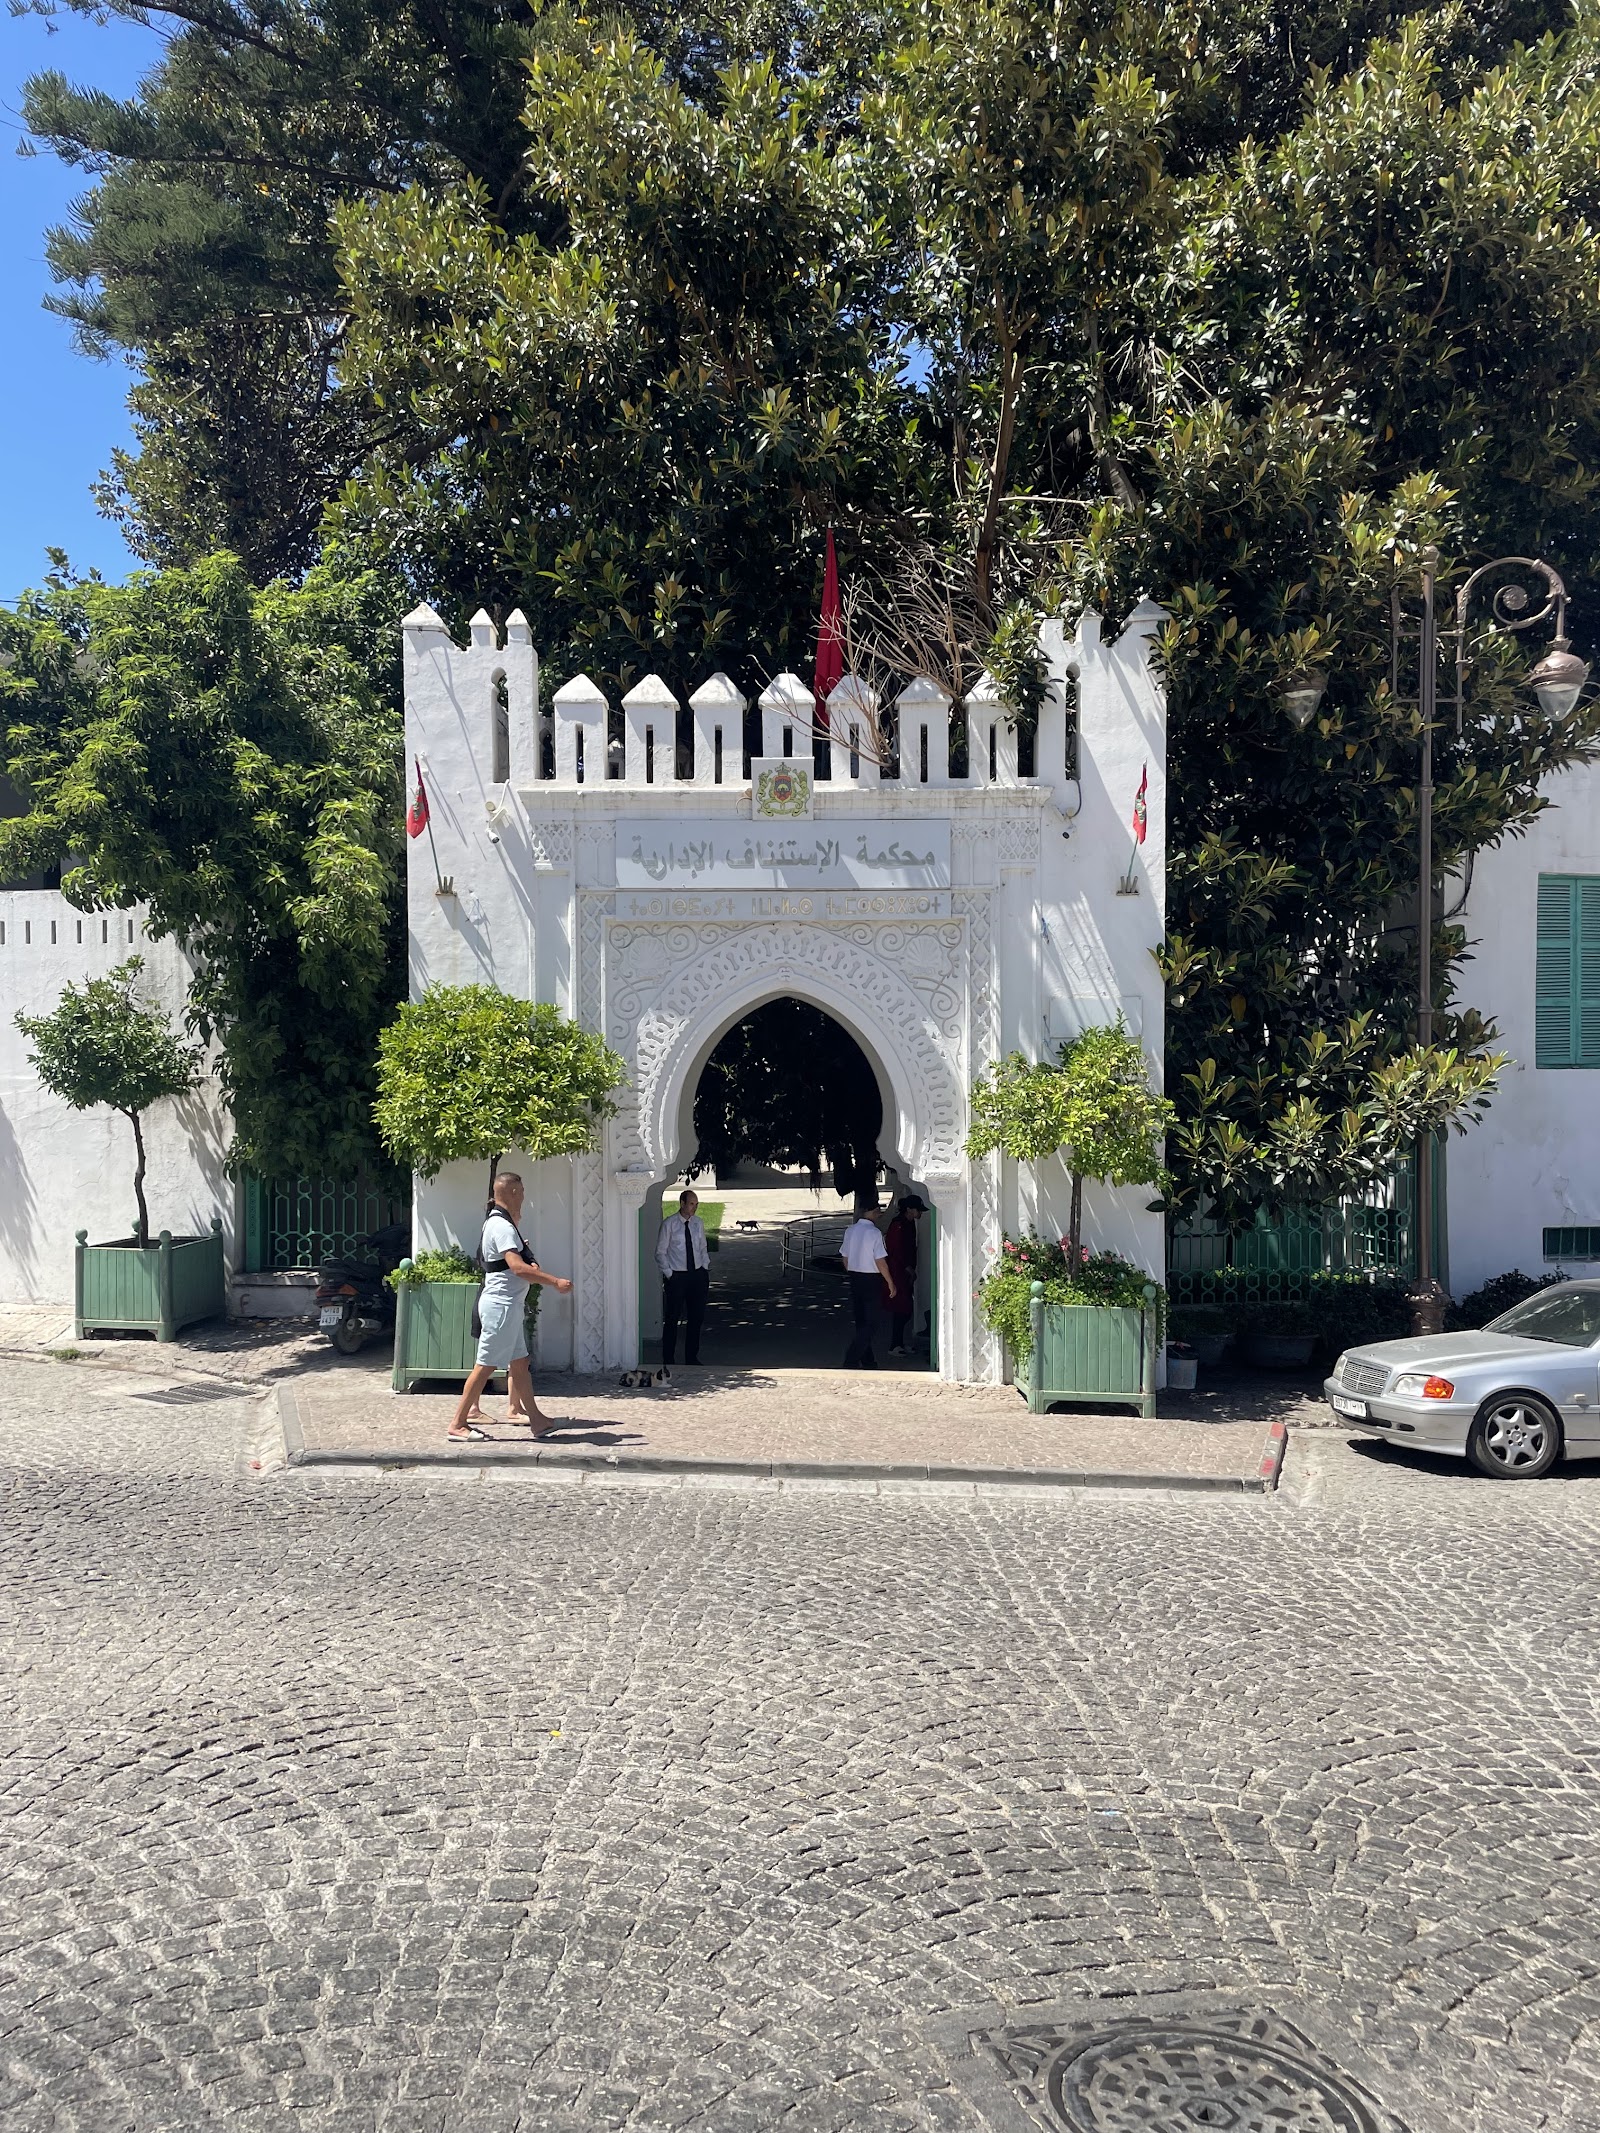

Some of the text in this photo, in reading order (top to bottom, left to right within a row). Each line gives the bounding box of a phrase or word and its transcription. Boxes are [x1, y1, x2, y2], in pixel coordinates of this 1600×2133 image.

[631, 834, 936, 881] محكمة الإستئناف الإدارية
